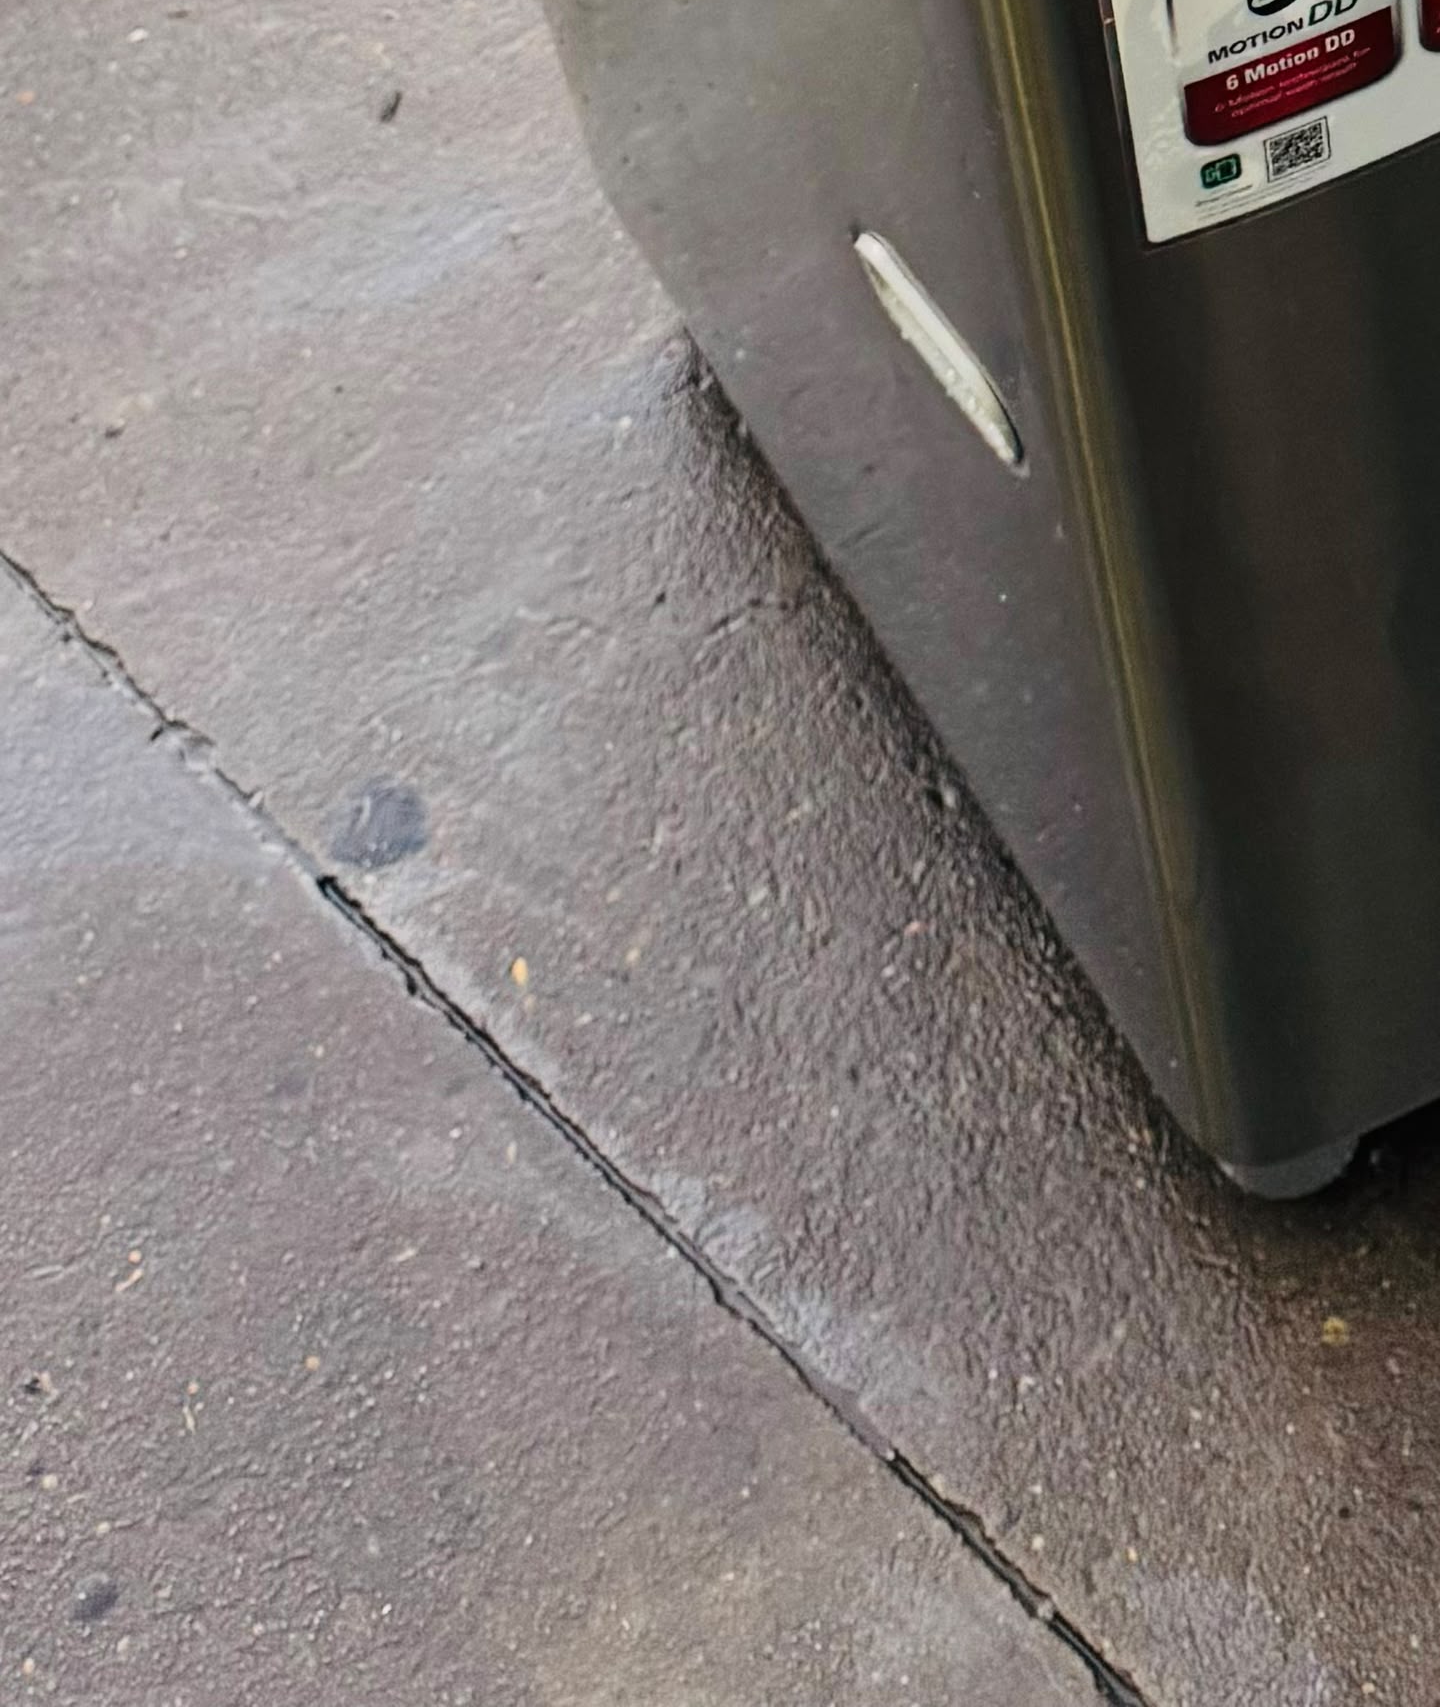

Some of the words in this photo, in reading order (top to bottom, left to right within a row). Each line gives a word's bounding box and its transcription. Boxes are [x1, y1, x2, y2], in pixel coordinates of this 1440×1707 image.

[1207, 17, 1305, 66] MOTION
[1225, 73, 1240, 92] 6
[1244, 45, 1321, 85] Motion
[1324, 28, 1356, 53] DD
